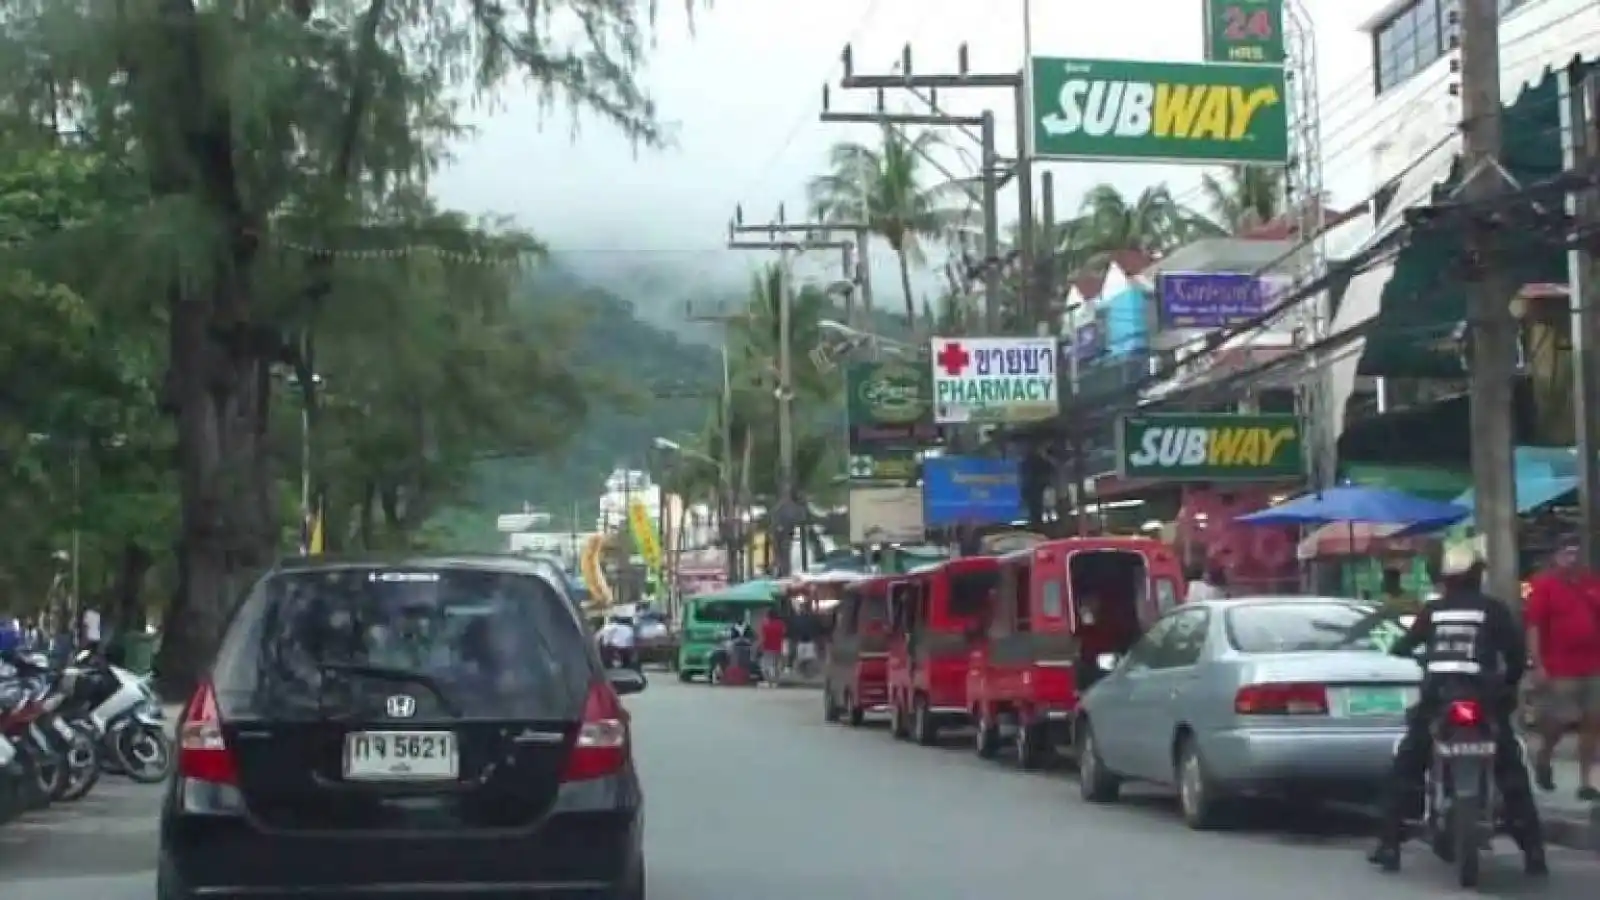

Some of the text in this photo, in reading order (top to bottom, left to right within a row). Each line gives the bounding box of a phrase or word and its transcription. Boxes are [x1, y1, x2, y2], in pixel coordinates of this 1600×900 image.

[1222, 6, 1272, 39] 24
[1041, 79, 1278, 140] SUBWAY
[975, 347, 1053, 375] ขายยา
[938, 378, 1053, 401] PHARMACY
[1128, 424, 1296, 467] SUBWAY
[393, 735, 447, 758] 5621
